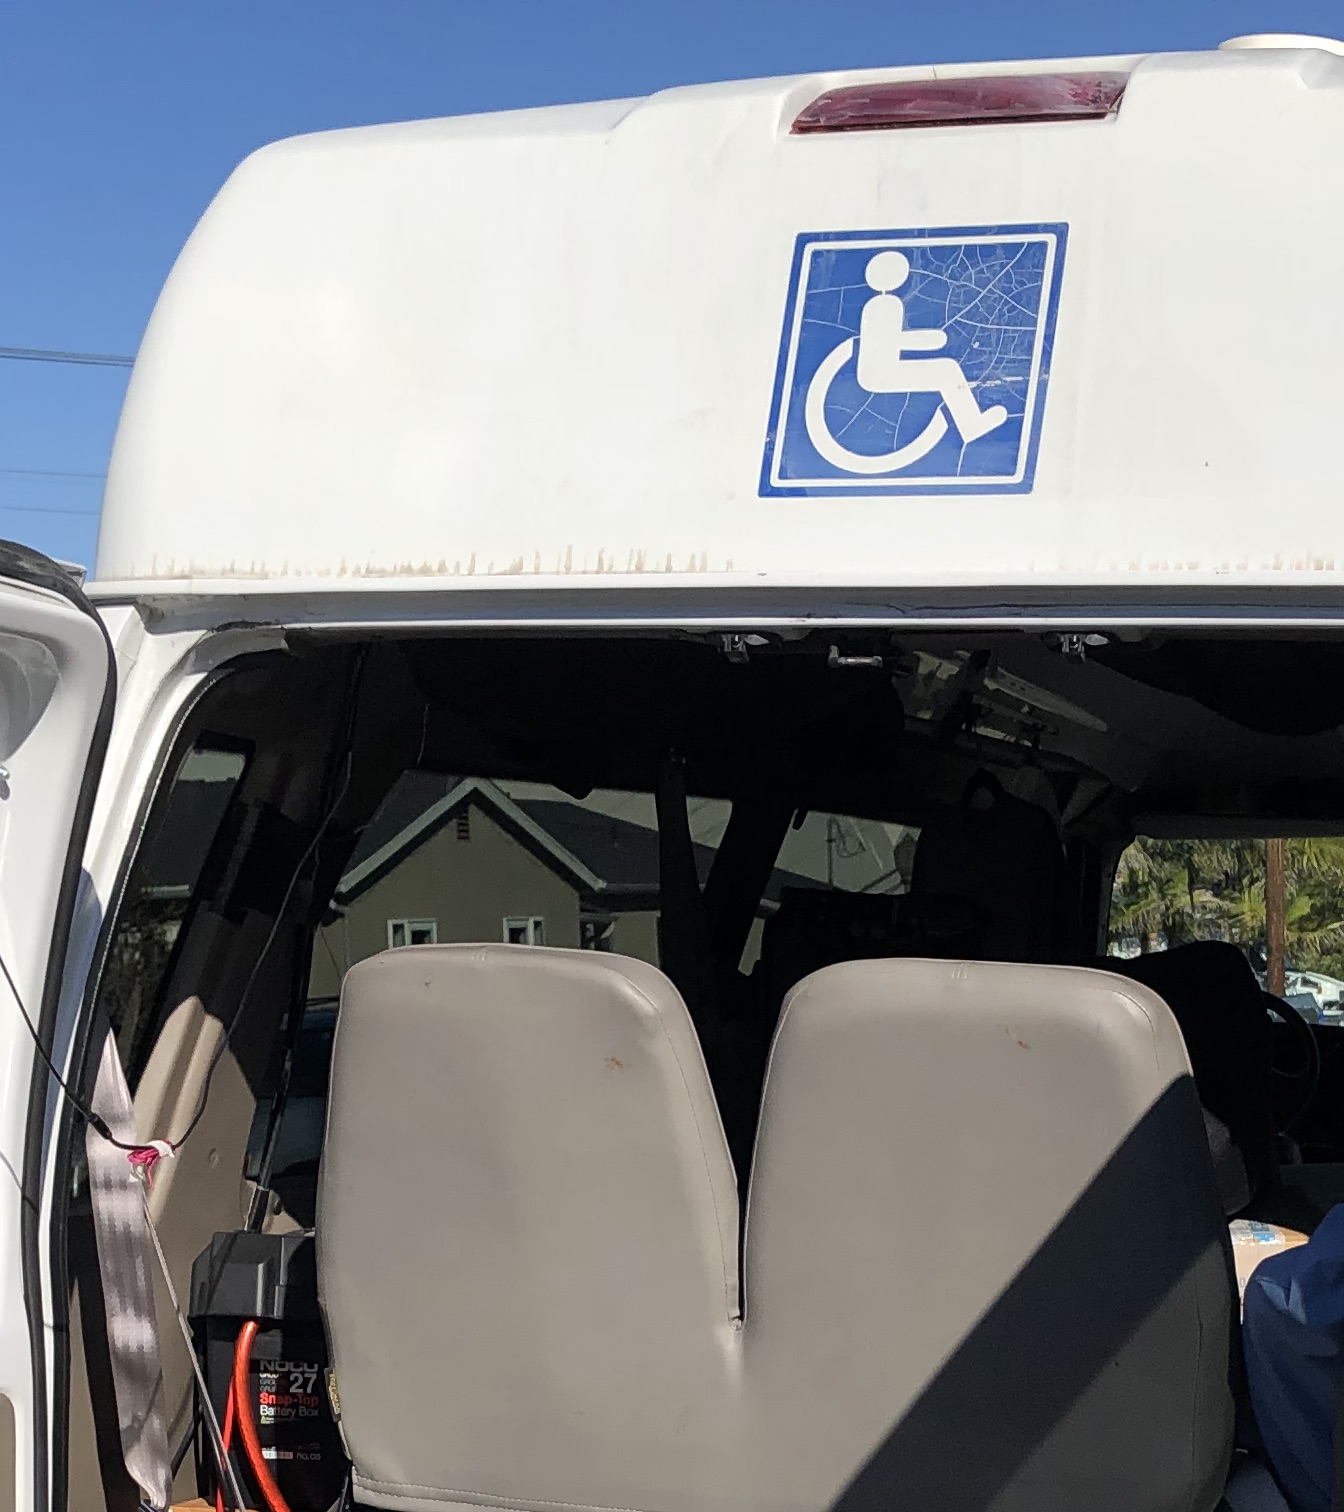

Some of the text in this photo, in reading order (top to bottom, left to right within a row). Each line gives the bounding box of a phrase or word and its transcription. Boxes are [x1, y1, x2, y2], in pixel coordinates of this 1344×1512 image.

[289, 1372, 317, 1394] 27
[259, 1391, 320, 1408] Snap-Top
[259, 1404, 320, 1419] Battery Box
